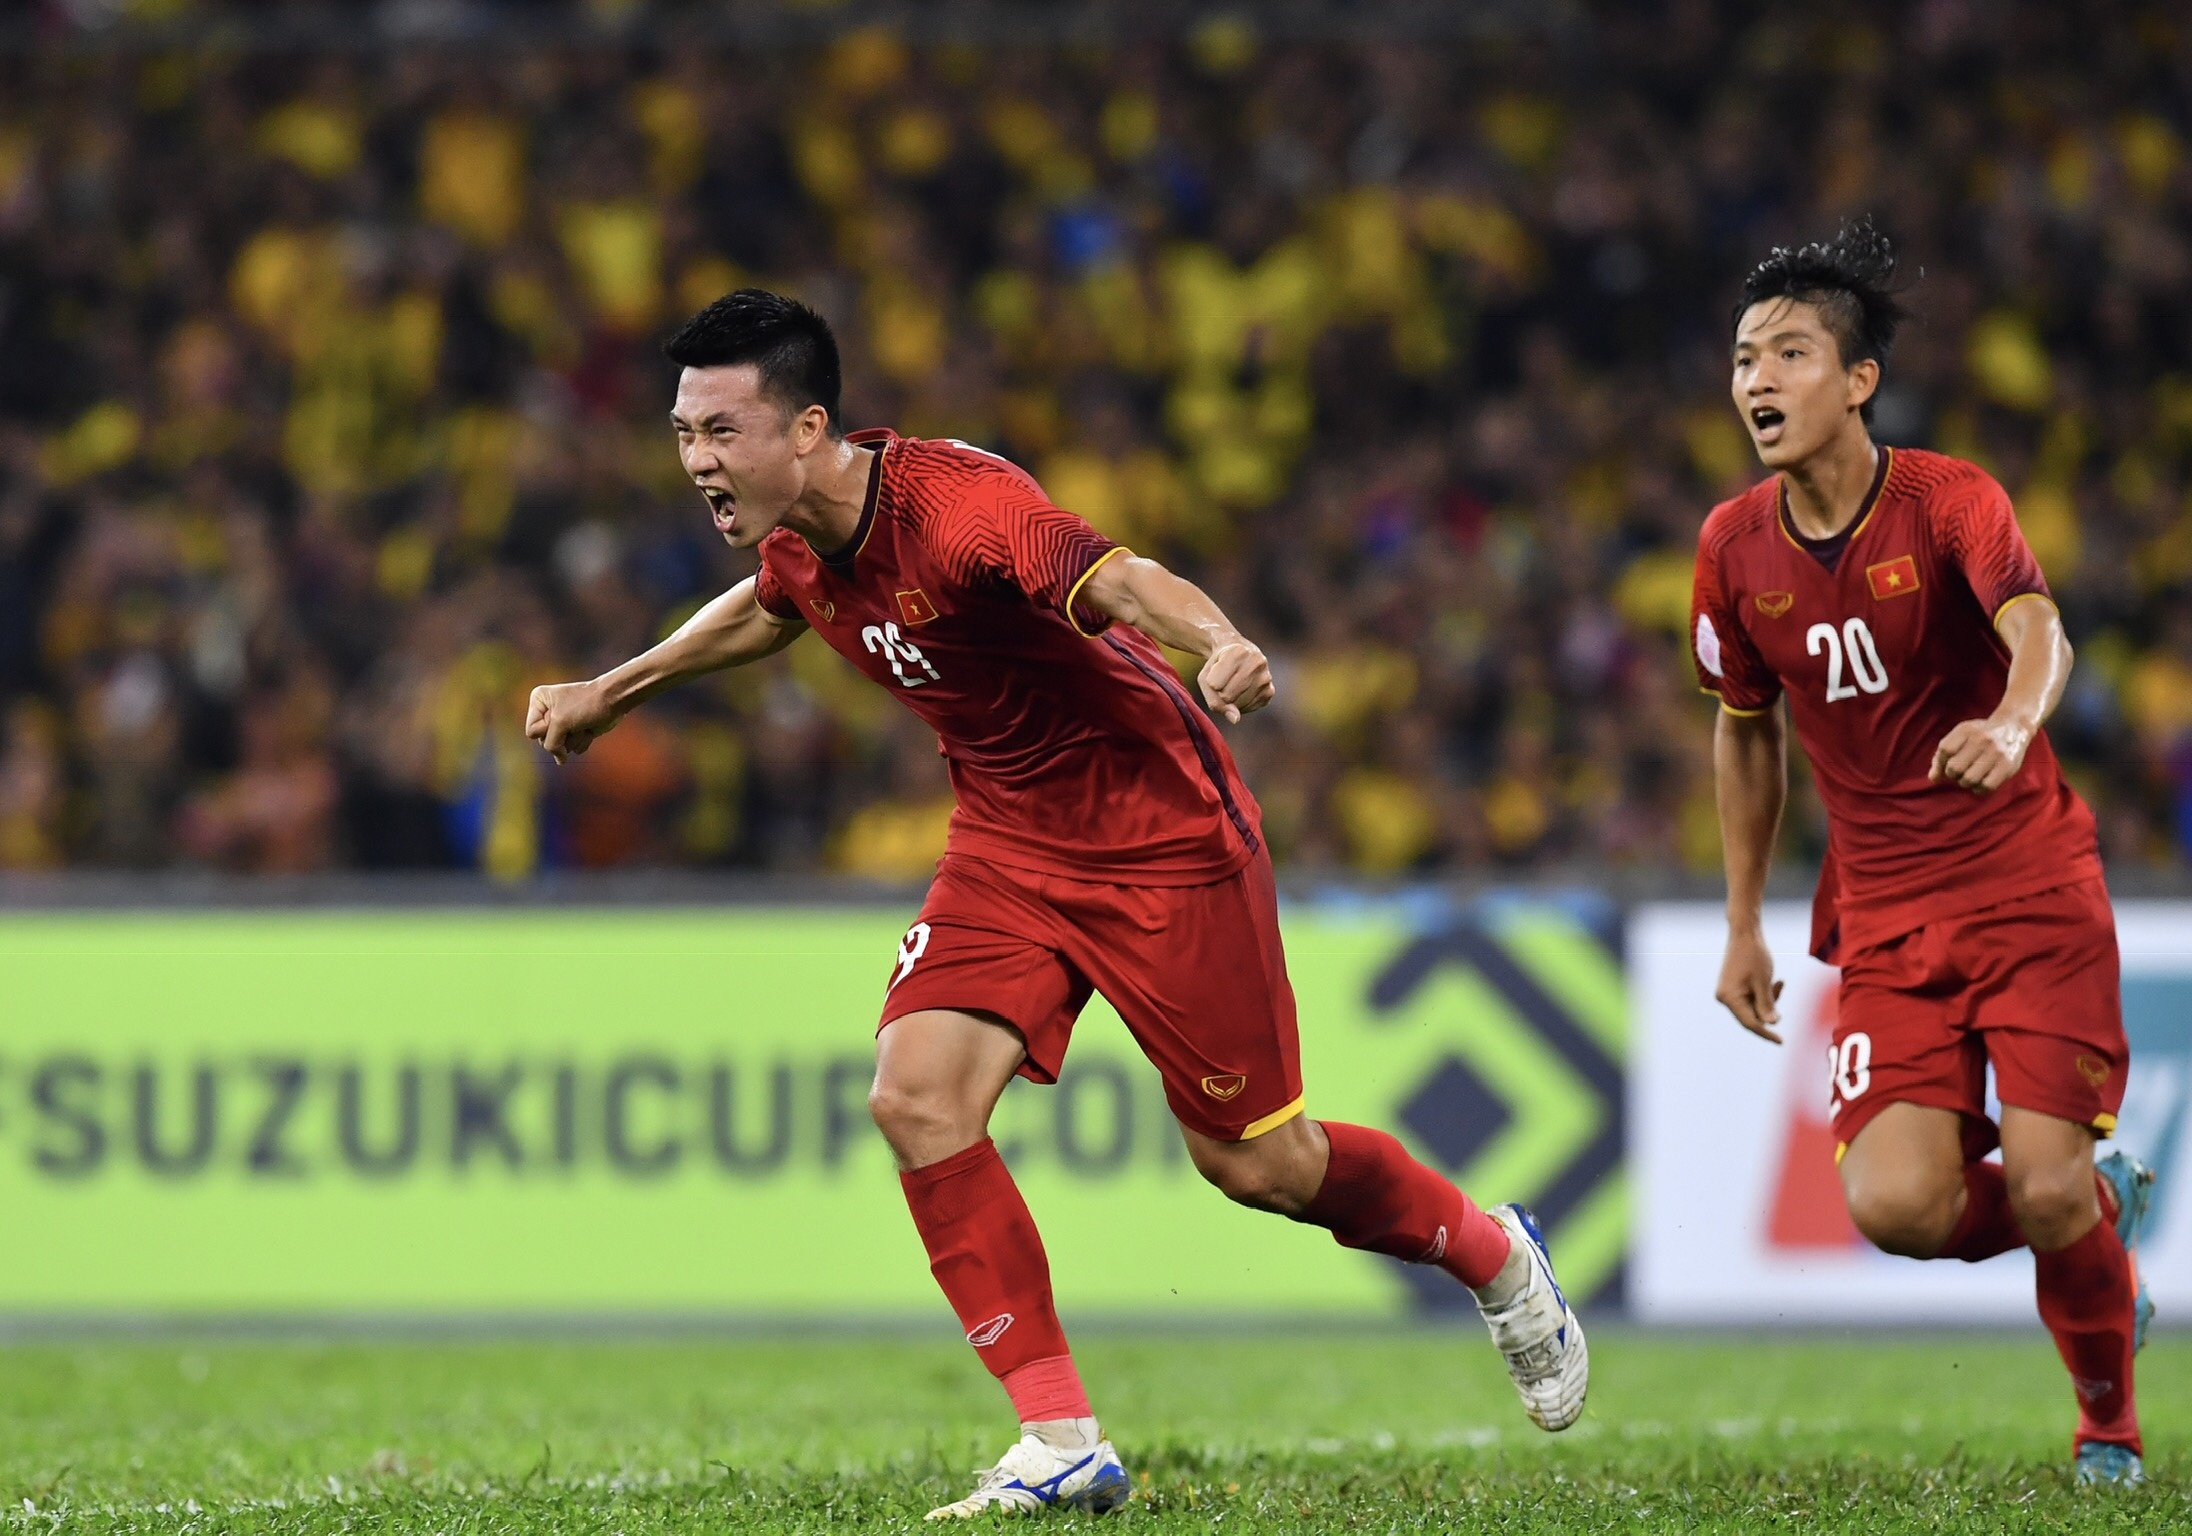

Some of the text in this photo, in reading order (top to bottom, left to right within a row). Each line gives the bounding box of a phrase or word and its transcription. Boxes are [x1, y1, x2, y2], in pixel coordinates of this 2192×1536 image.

[862, 621, 941, 688] 29
[1806, 617, 1889, 703] 20
[885, 921, 932, 1002] 9
